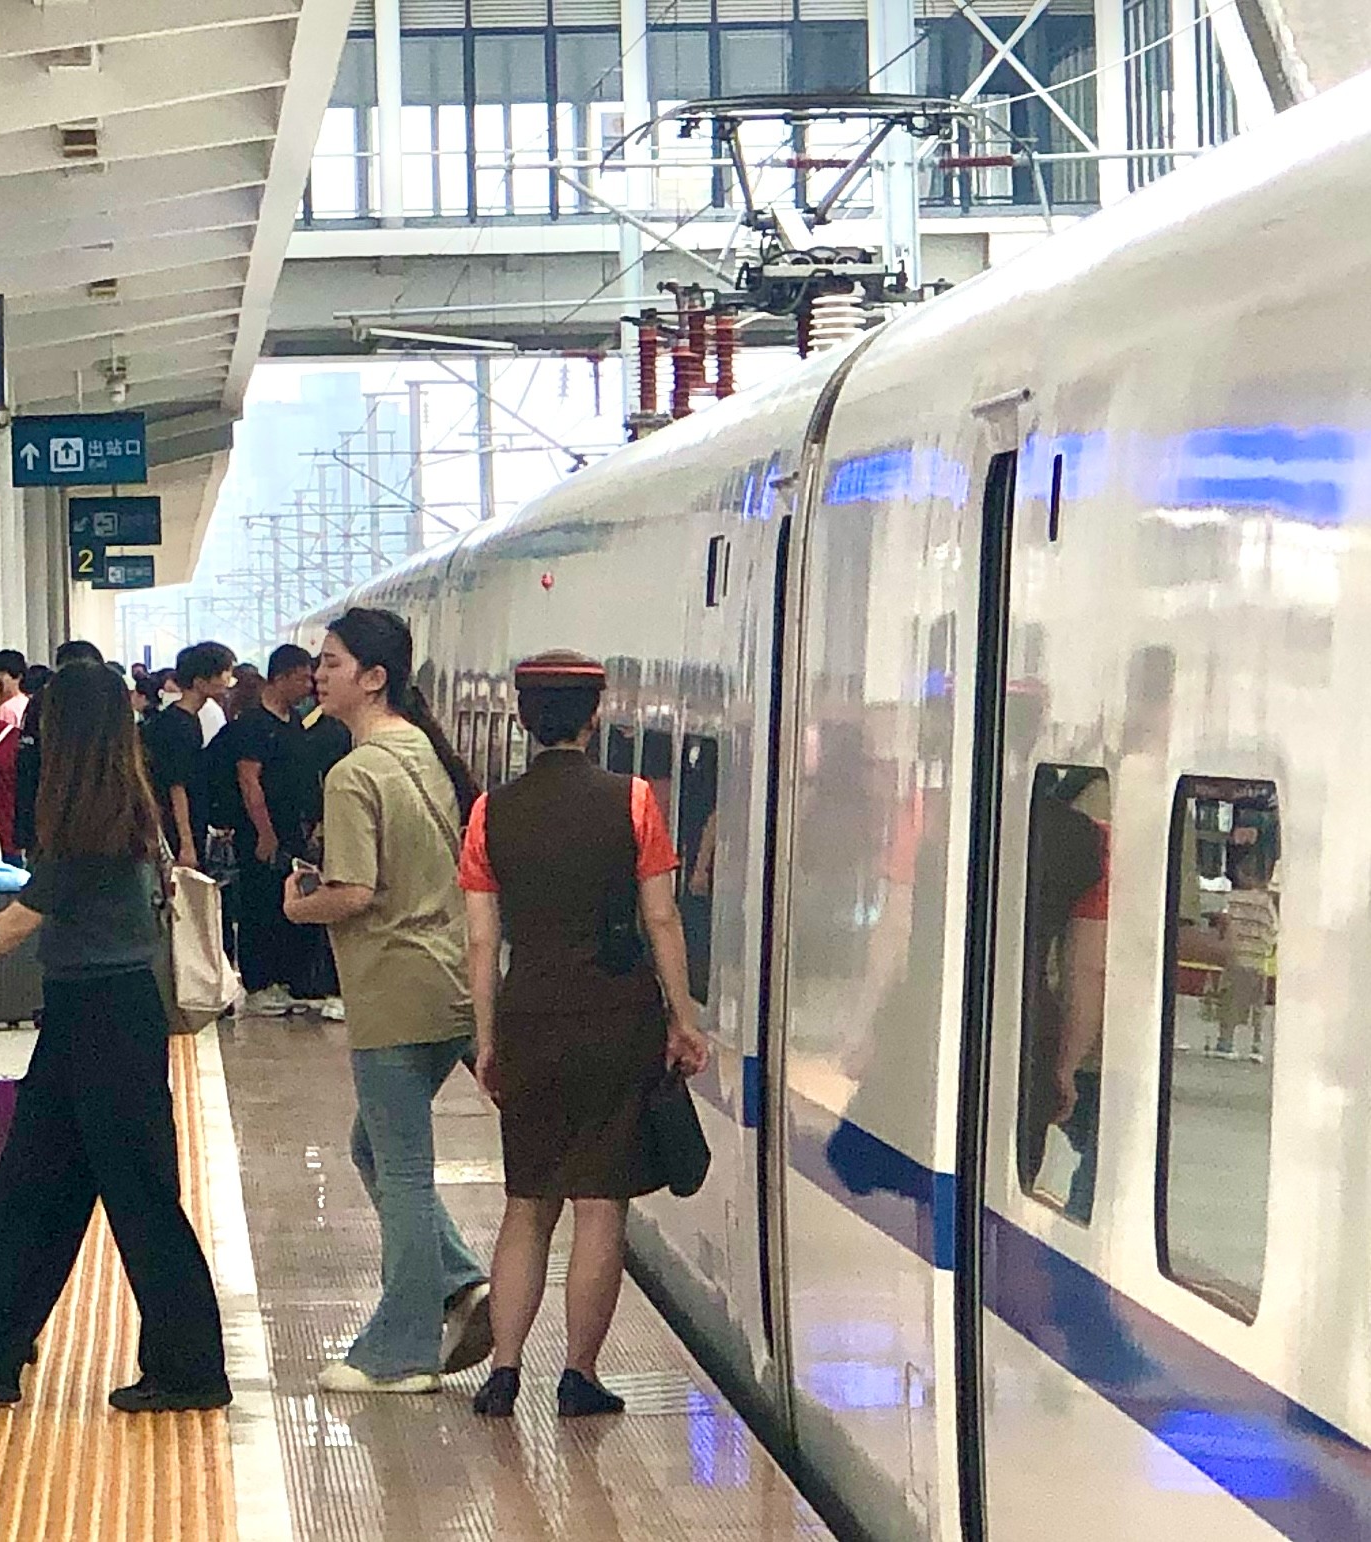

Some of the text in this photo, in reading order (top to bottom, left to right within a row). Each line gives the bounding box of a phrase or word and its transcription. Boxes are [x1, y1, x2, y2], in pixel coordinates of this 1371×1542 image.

[88, 438, 140, 456] 出站口
[78, 549, 94, 573] 2
